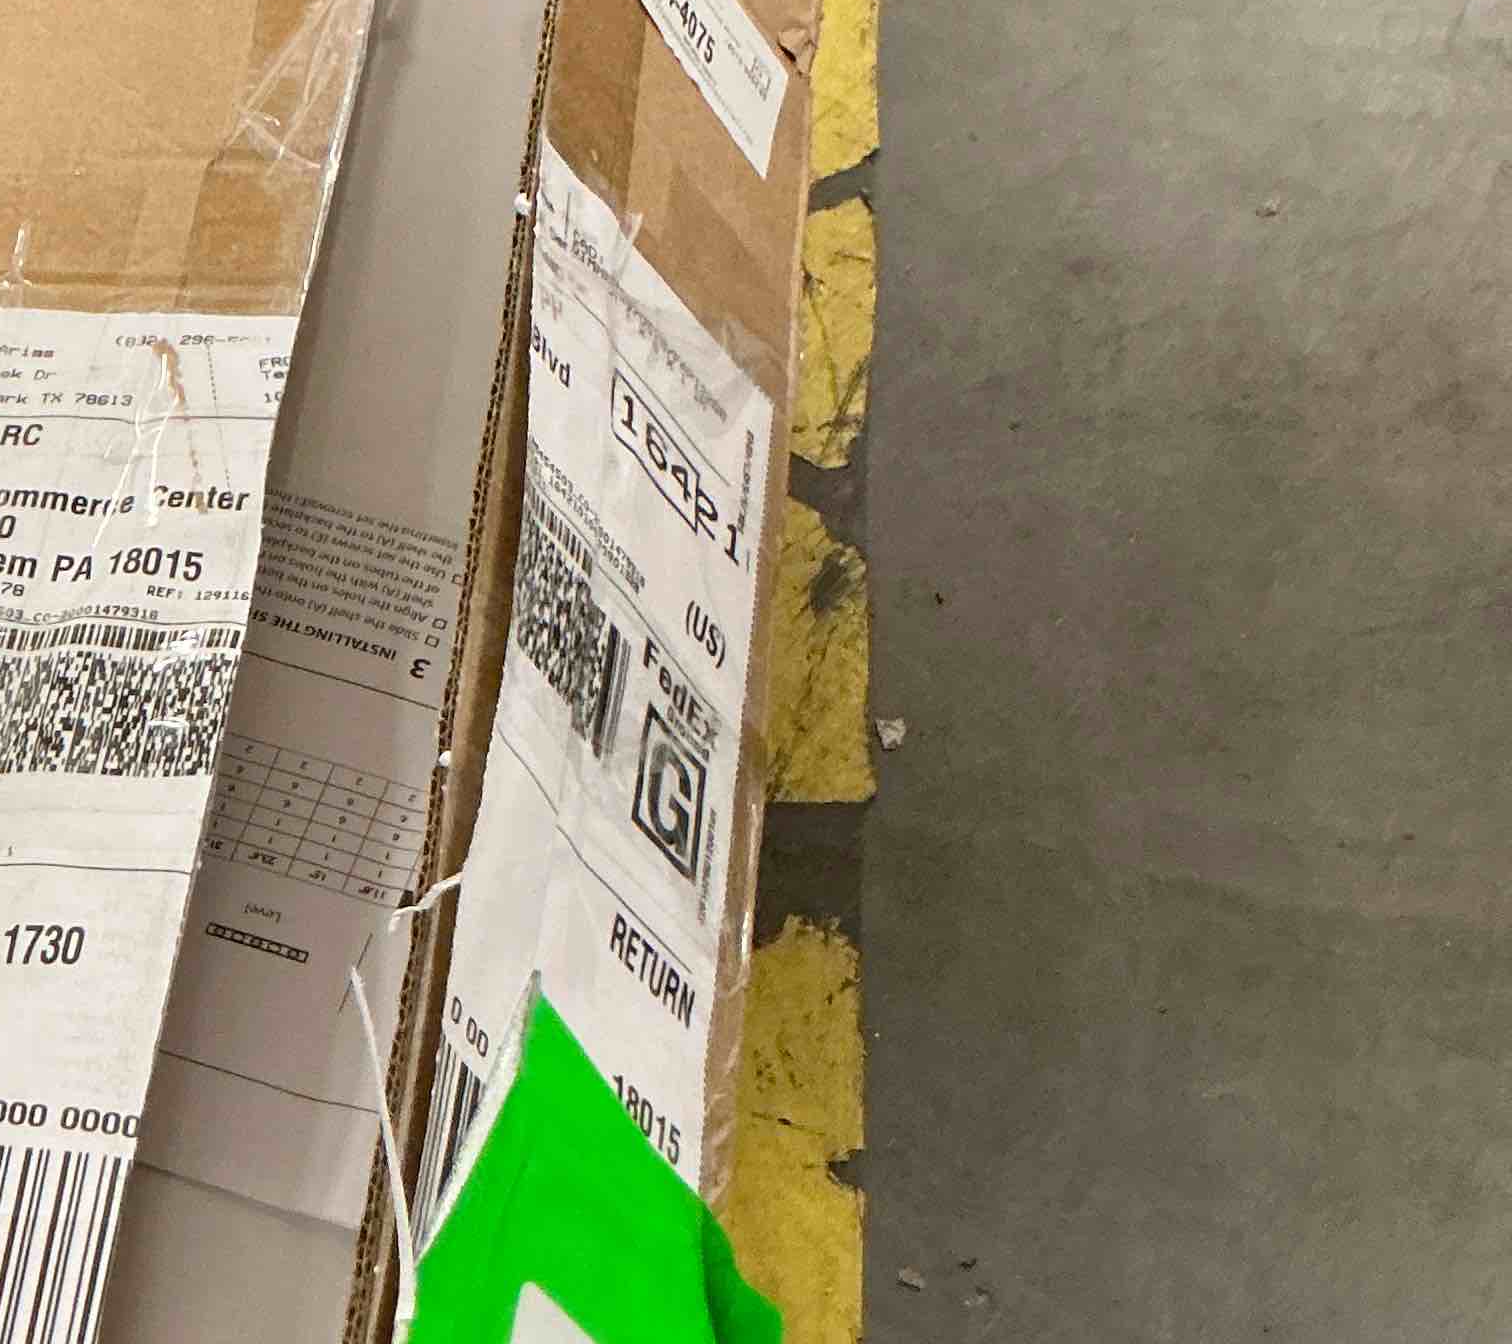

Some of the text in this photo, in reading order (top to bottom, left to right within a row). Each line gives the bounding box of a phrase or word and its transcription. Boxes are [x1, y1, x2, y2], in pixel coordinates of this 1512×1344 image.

[40, 392, 64, 404] TX
[75, 392, 133, 406] 78613
[0, 424, 44, 447] RC
[50, 554, 93, 582] PA
[109, 546, 205, 582] 18015
[146, 585, 184, 600] REF:
[268, 613, 302, 633] THE
[685, 600, 726, 669] (US)
[301, 623, 398, 661] INSTALLING
[407, 657, 430, 680] 3
[4, 924, 86, 966] 1730
[609, 912, 696, 1029] RETURN
[59, 1105, 141, 1139] 0000
